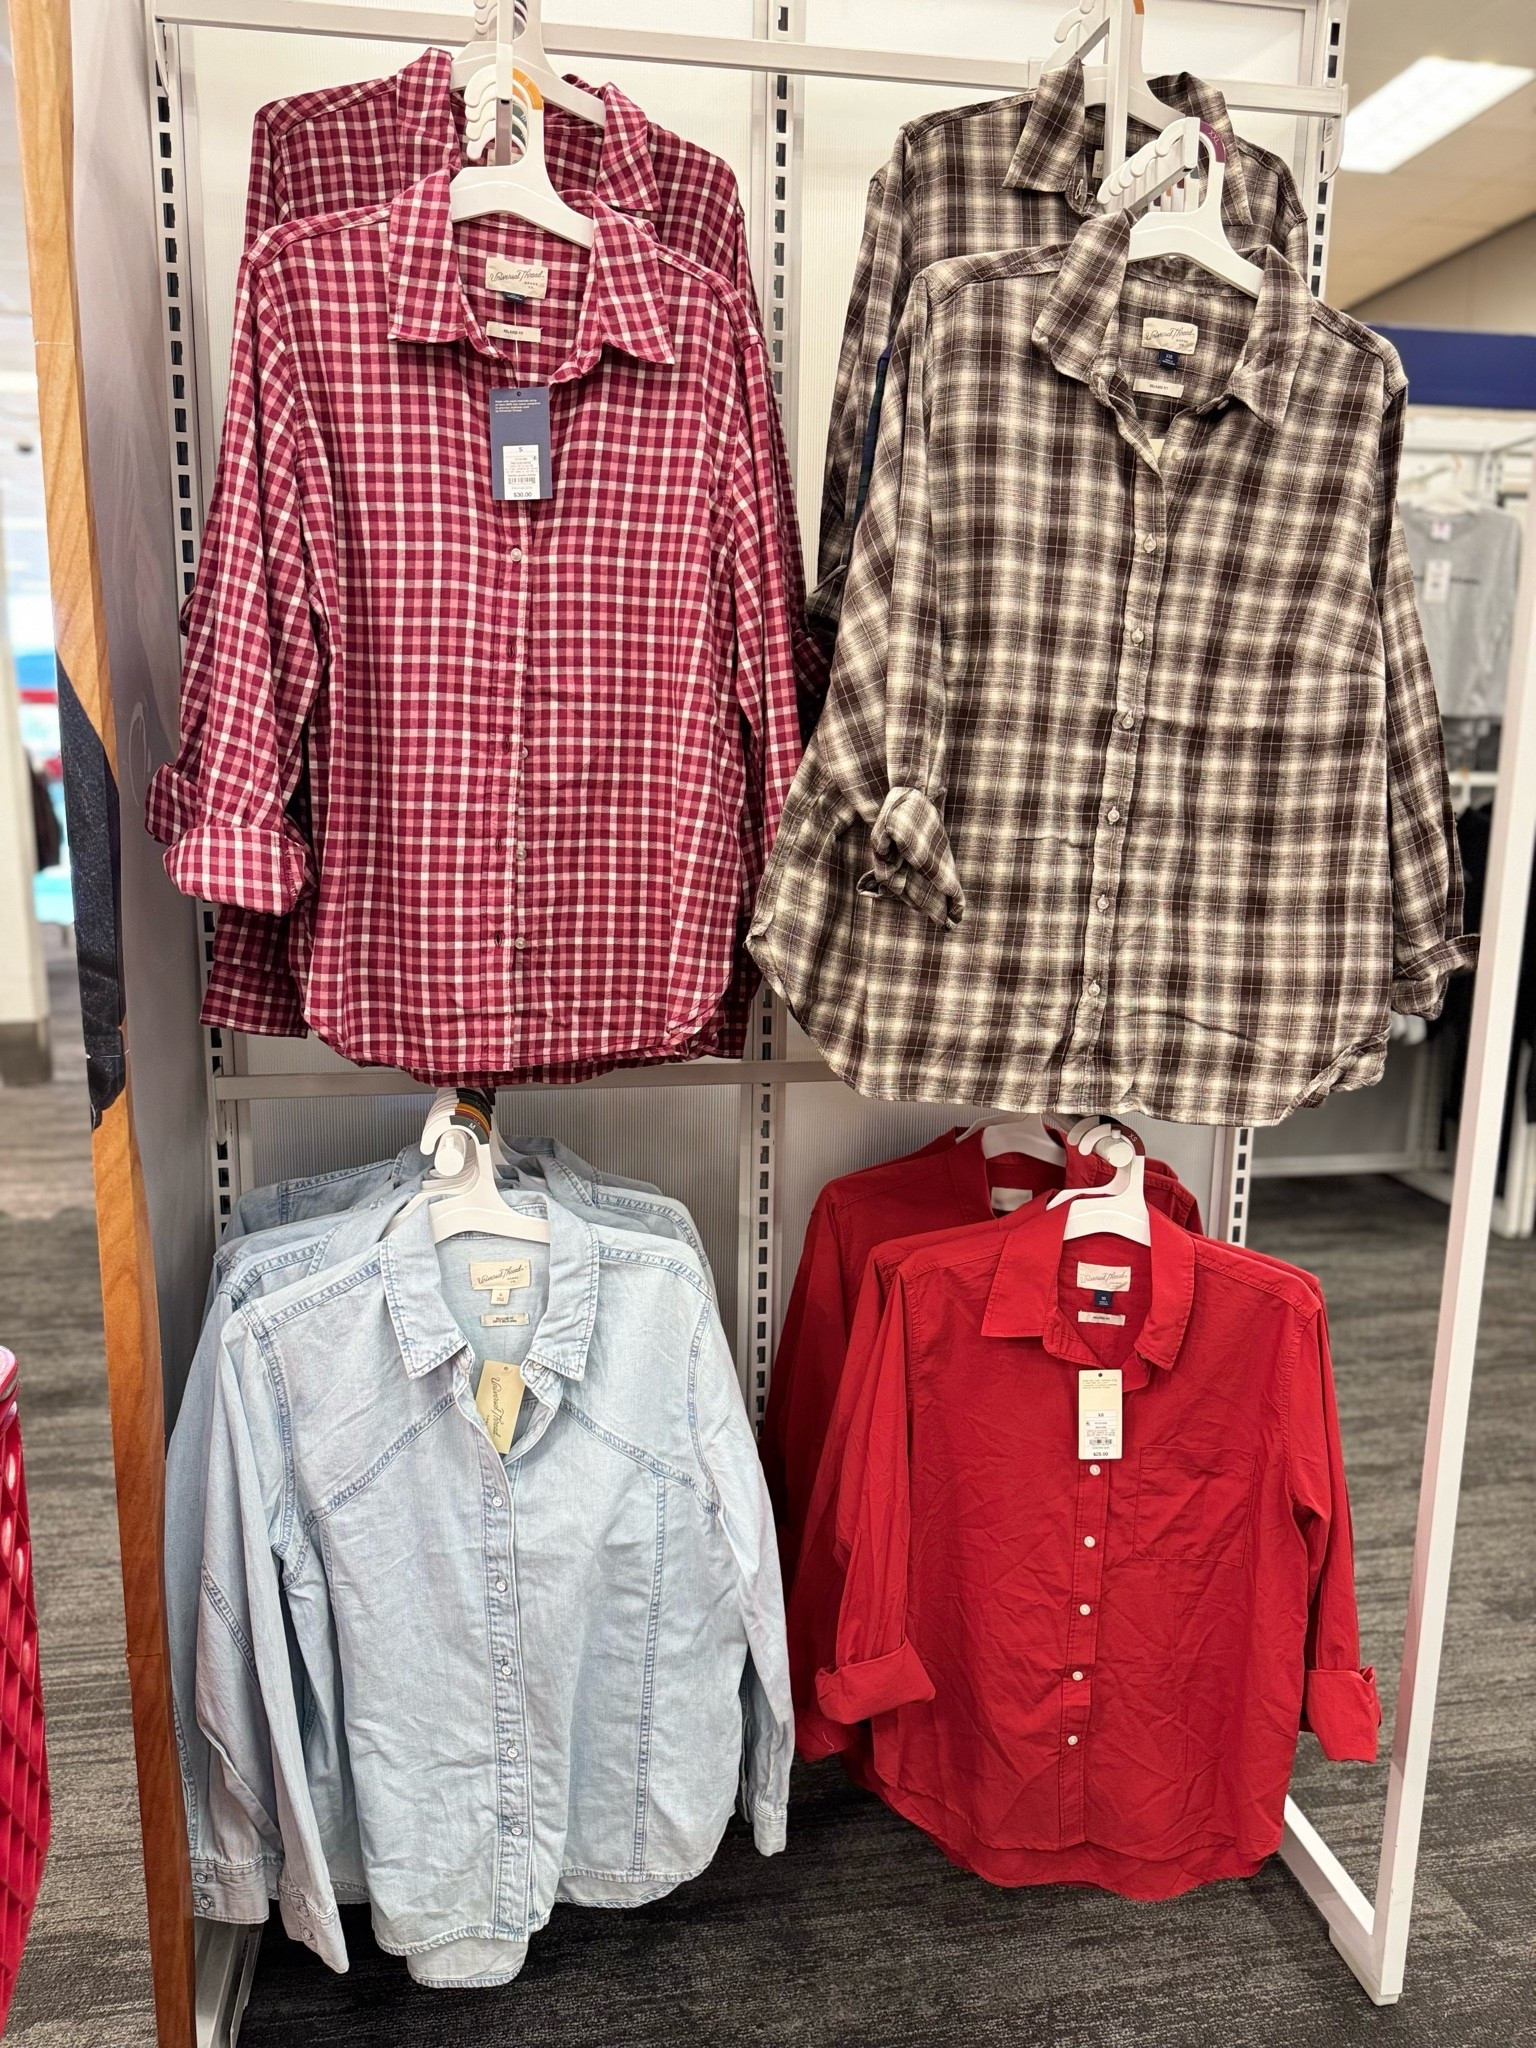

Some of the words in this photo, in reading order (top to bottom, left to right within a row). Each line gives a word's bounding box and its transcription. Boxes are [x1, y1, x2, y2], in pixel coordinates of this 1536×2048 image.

[1208, 130, 1220, 145] XXL
[490, 271, 520, 283] Universal
[517, 268, 544, 282] Thread
[1145, 329, 1173, 341] Universal
[1170, 326, 1194, 339] Thread
[468, 1122, 476, 1131] M
[1128, 1133, 1138, 1142] XS
[477, 1270, 503, 1285] Universal
[499, 1264, 522, 1279] Thread
[1080, 1272, 1107, 1284] Universal
[1103, 1271, 1126, 1282] Thread
[490, 1376, 502, 1413] Universal
[490, 1408, 505, 1438] Thread
